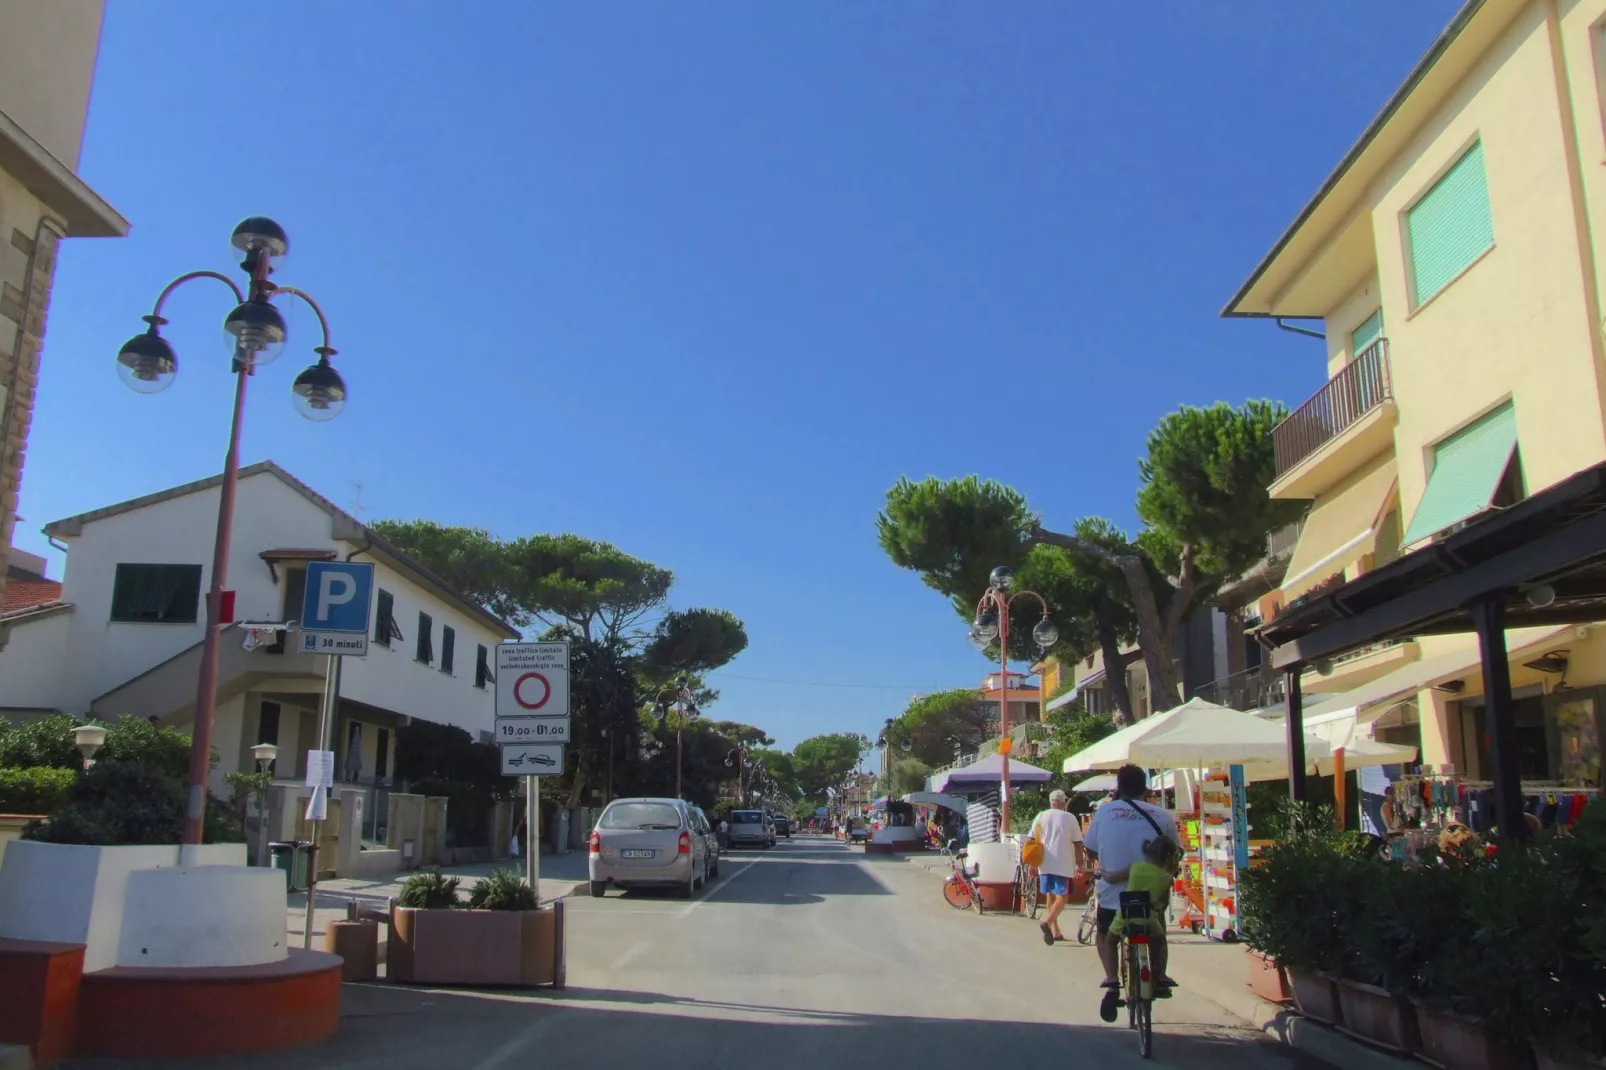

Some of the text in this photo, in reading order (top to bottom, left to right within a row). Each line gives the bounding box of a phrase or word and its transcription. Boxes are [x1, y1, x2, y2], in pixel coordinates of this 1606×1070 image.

[316, 571, 357, 621] P
[322, 639, 363, 649] 30 minuti
